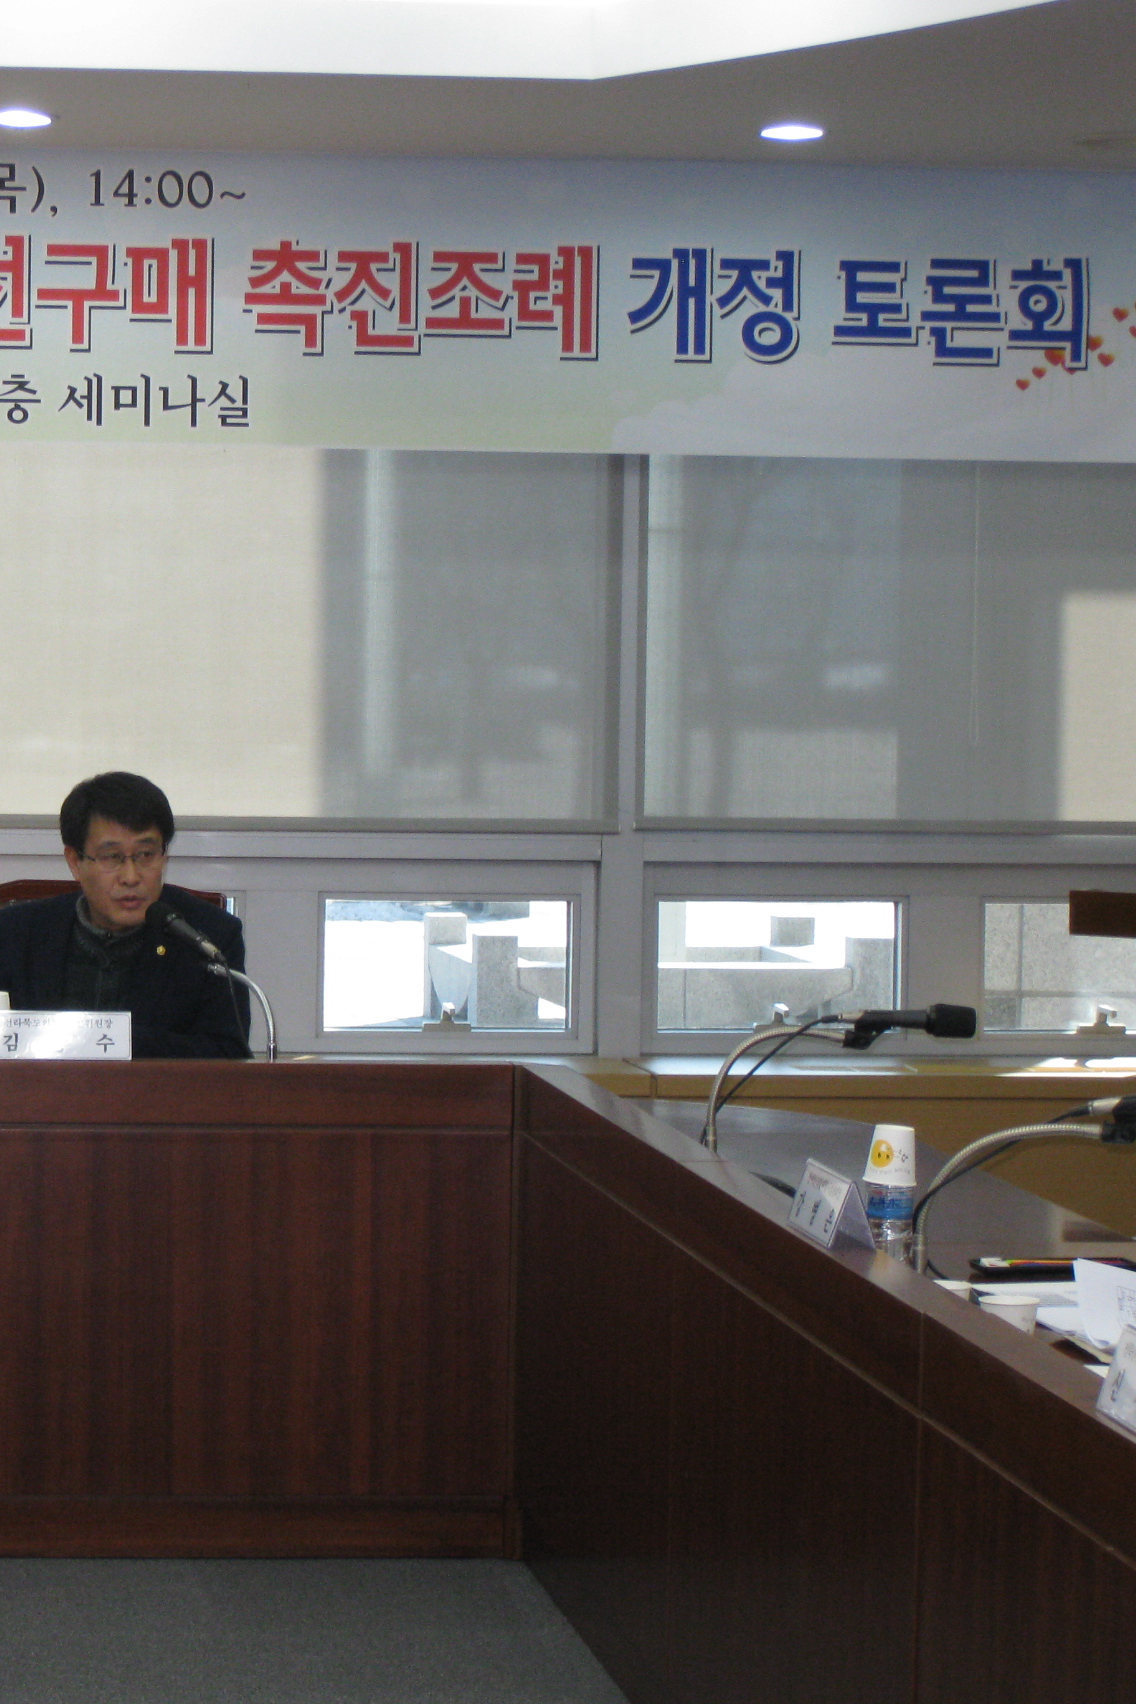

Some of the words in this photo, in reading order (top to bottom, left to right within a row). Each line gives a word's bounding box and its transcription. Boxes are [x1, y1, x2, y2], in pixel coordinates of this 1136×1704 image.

[88, 168, 248, 209] 14:00~
[242, 240, 599, 362] 촉진조례
[627, 247, 802, 364] 개정
[831, 256, 1091, 371] 토론회
[57, 373, 252, 429] 세미나실
